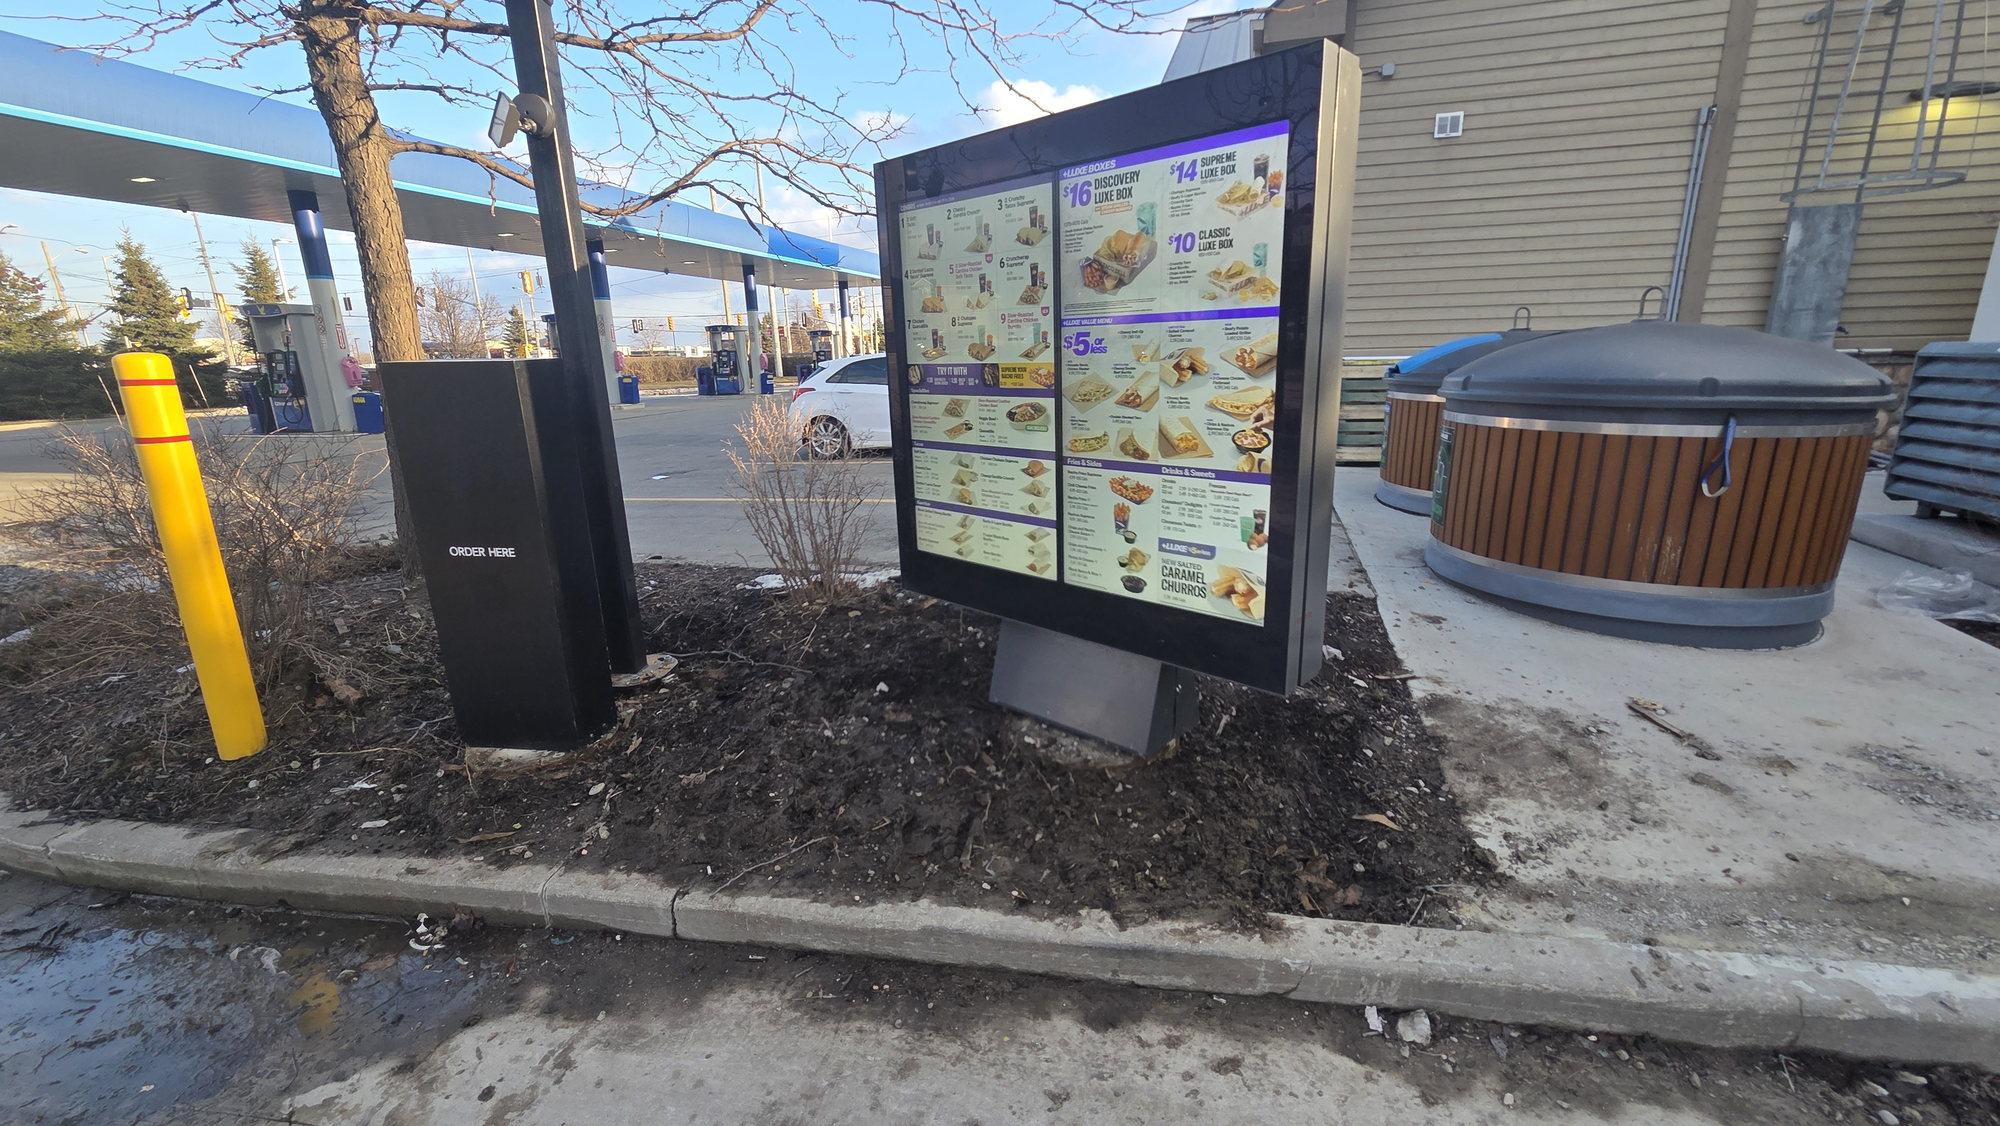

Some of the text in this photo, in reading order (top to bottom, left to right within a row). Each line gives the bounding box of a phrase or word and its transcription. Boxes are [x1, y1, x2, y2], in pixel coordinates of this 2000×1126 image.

[1200, 151, 1237, 168] SUPREME
[1088, 160, 1116, 172] BOXES
[1170, 159, 1198, 184] $14
[1200, 164, 1236, 180] LUXE BOX
[1094, 170, 1140, 190] DISCOVERY
[1063, 180, 1092, 208] $16
[1094, 186, 1133, 204] LUXE BOX
[998, 199, 1002, 210] 3
[947, 209, 952, 220] 2
[1199, 227, 1230, 240] CLASSIC
[1168, 232, 1196, 254] $10
[1198, 238, 1234, 252] LUXE BOX
[949, 264, 954, 275] 5
[1000, 258, 1005, 269] 6
[904, 270, 909, 280] 4
[907, 320, 912, 329] 7
[952, 317, 956, 327] 8
[1001, 313, 1006, 324] 9
[1063, 332, 1090, 356] $5
[1090, 343, 1108, 354] less
[937, 367, 968, 375] TRY IT WITH
[1162, 467, 1183, 475] Drinks
[1190, 469, 1216, 478] Sweets
[449, 546, 516, 558] ORDER HERE
[1177, 561, 1202, 570] SALTED
[1161, 565, 1207, 585] CARAMEL
[1161, 579, 1207, 598] CHURROS
